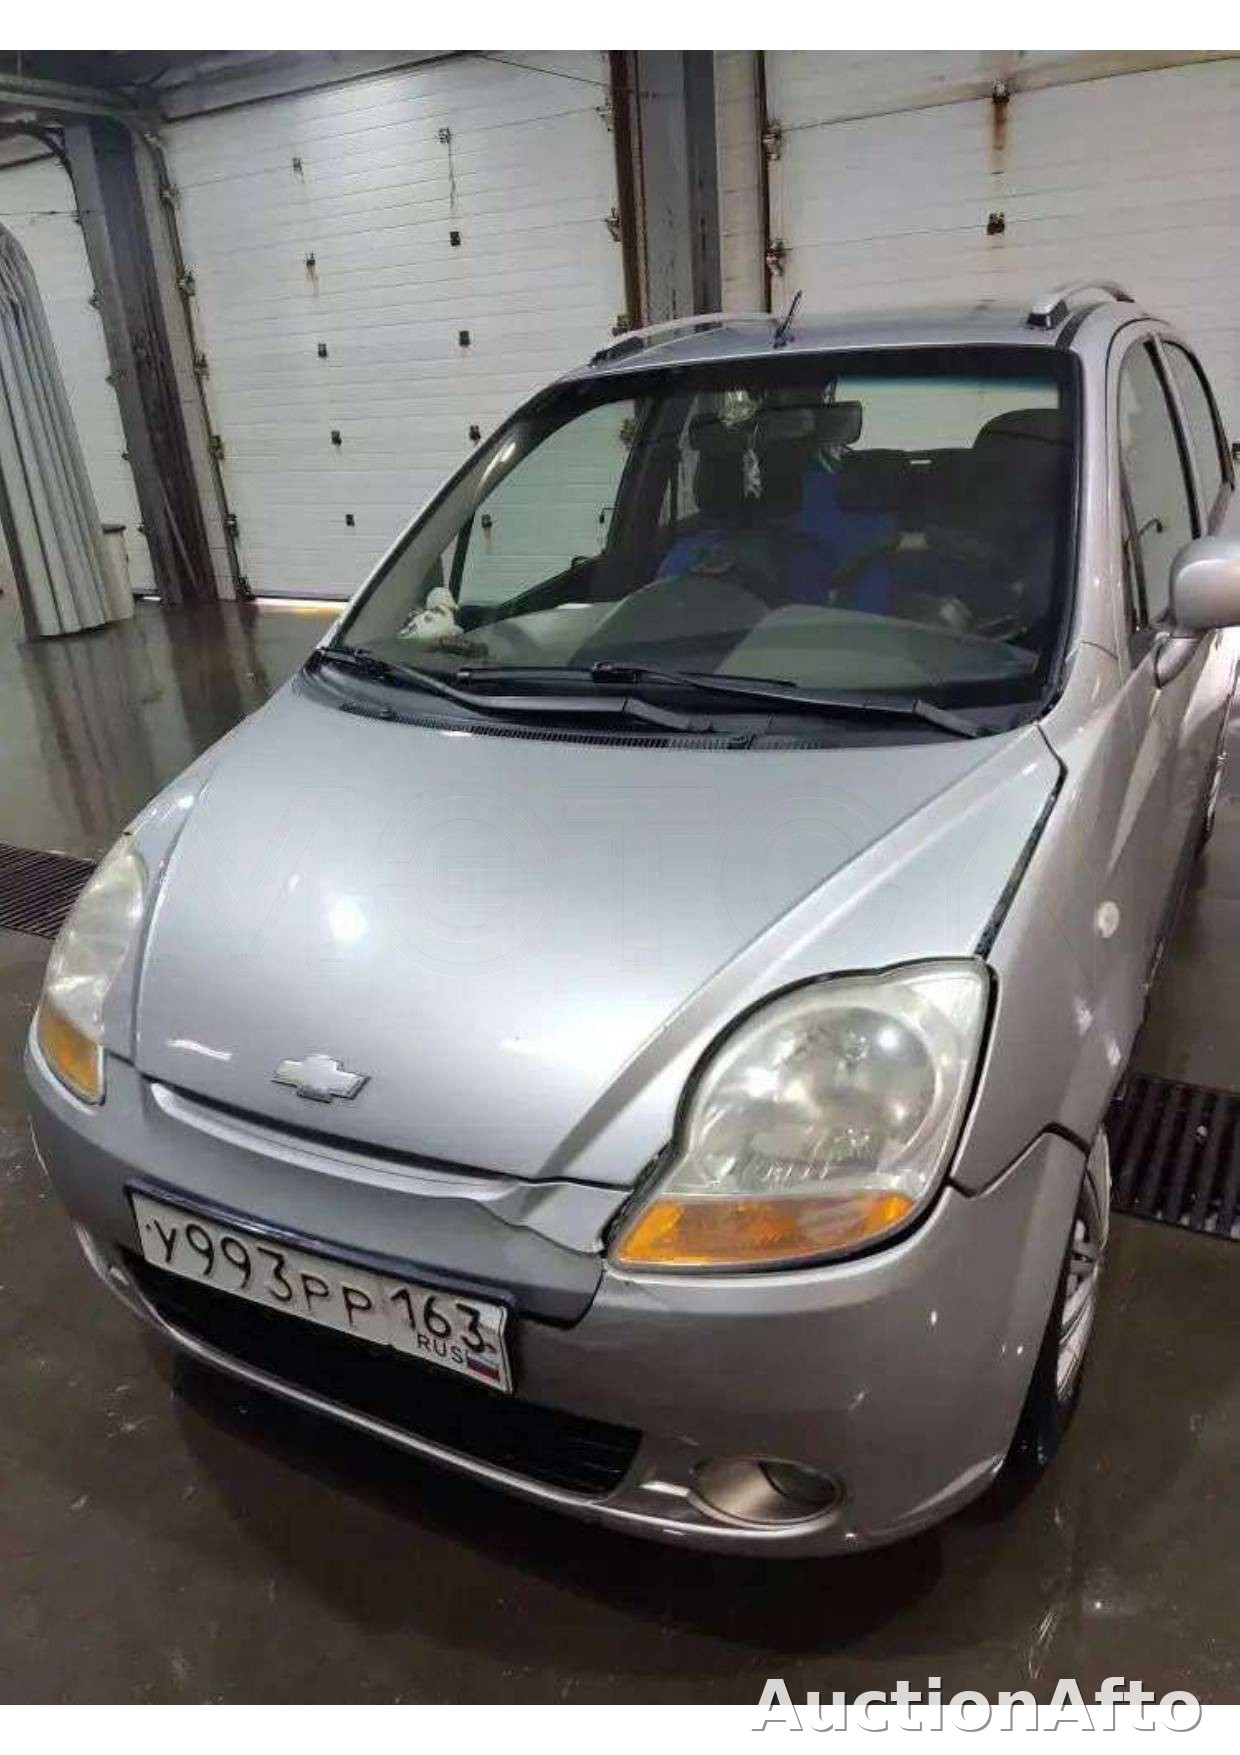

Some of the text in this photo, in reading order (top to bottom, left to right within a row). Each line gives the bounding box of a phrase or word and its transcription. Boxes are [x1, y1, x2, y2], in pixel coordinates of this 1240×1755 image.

[154, 1219, 488, 1354] У993РР 163
[417, 1332, 465, 1364] RUS
